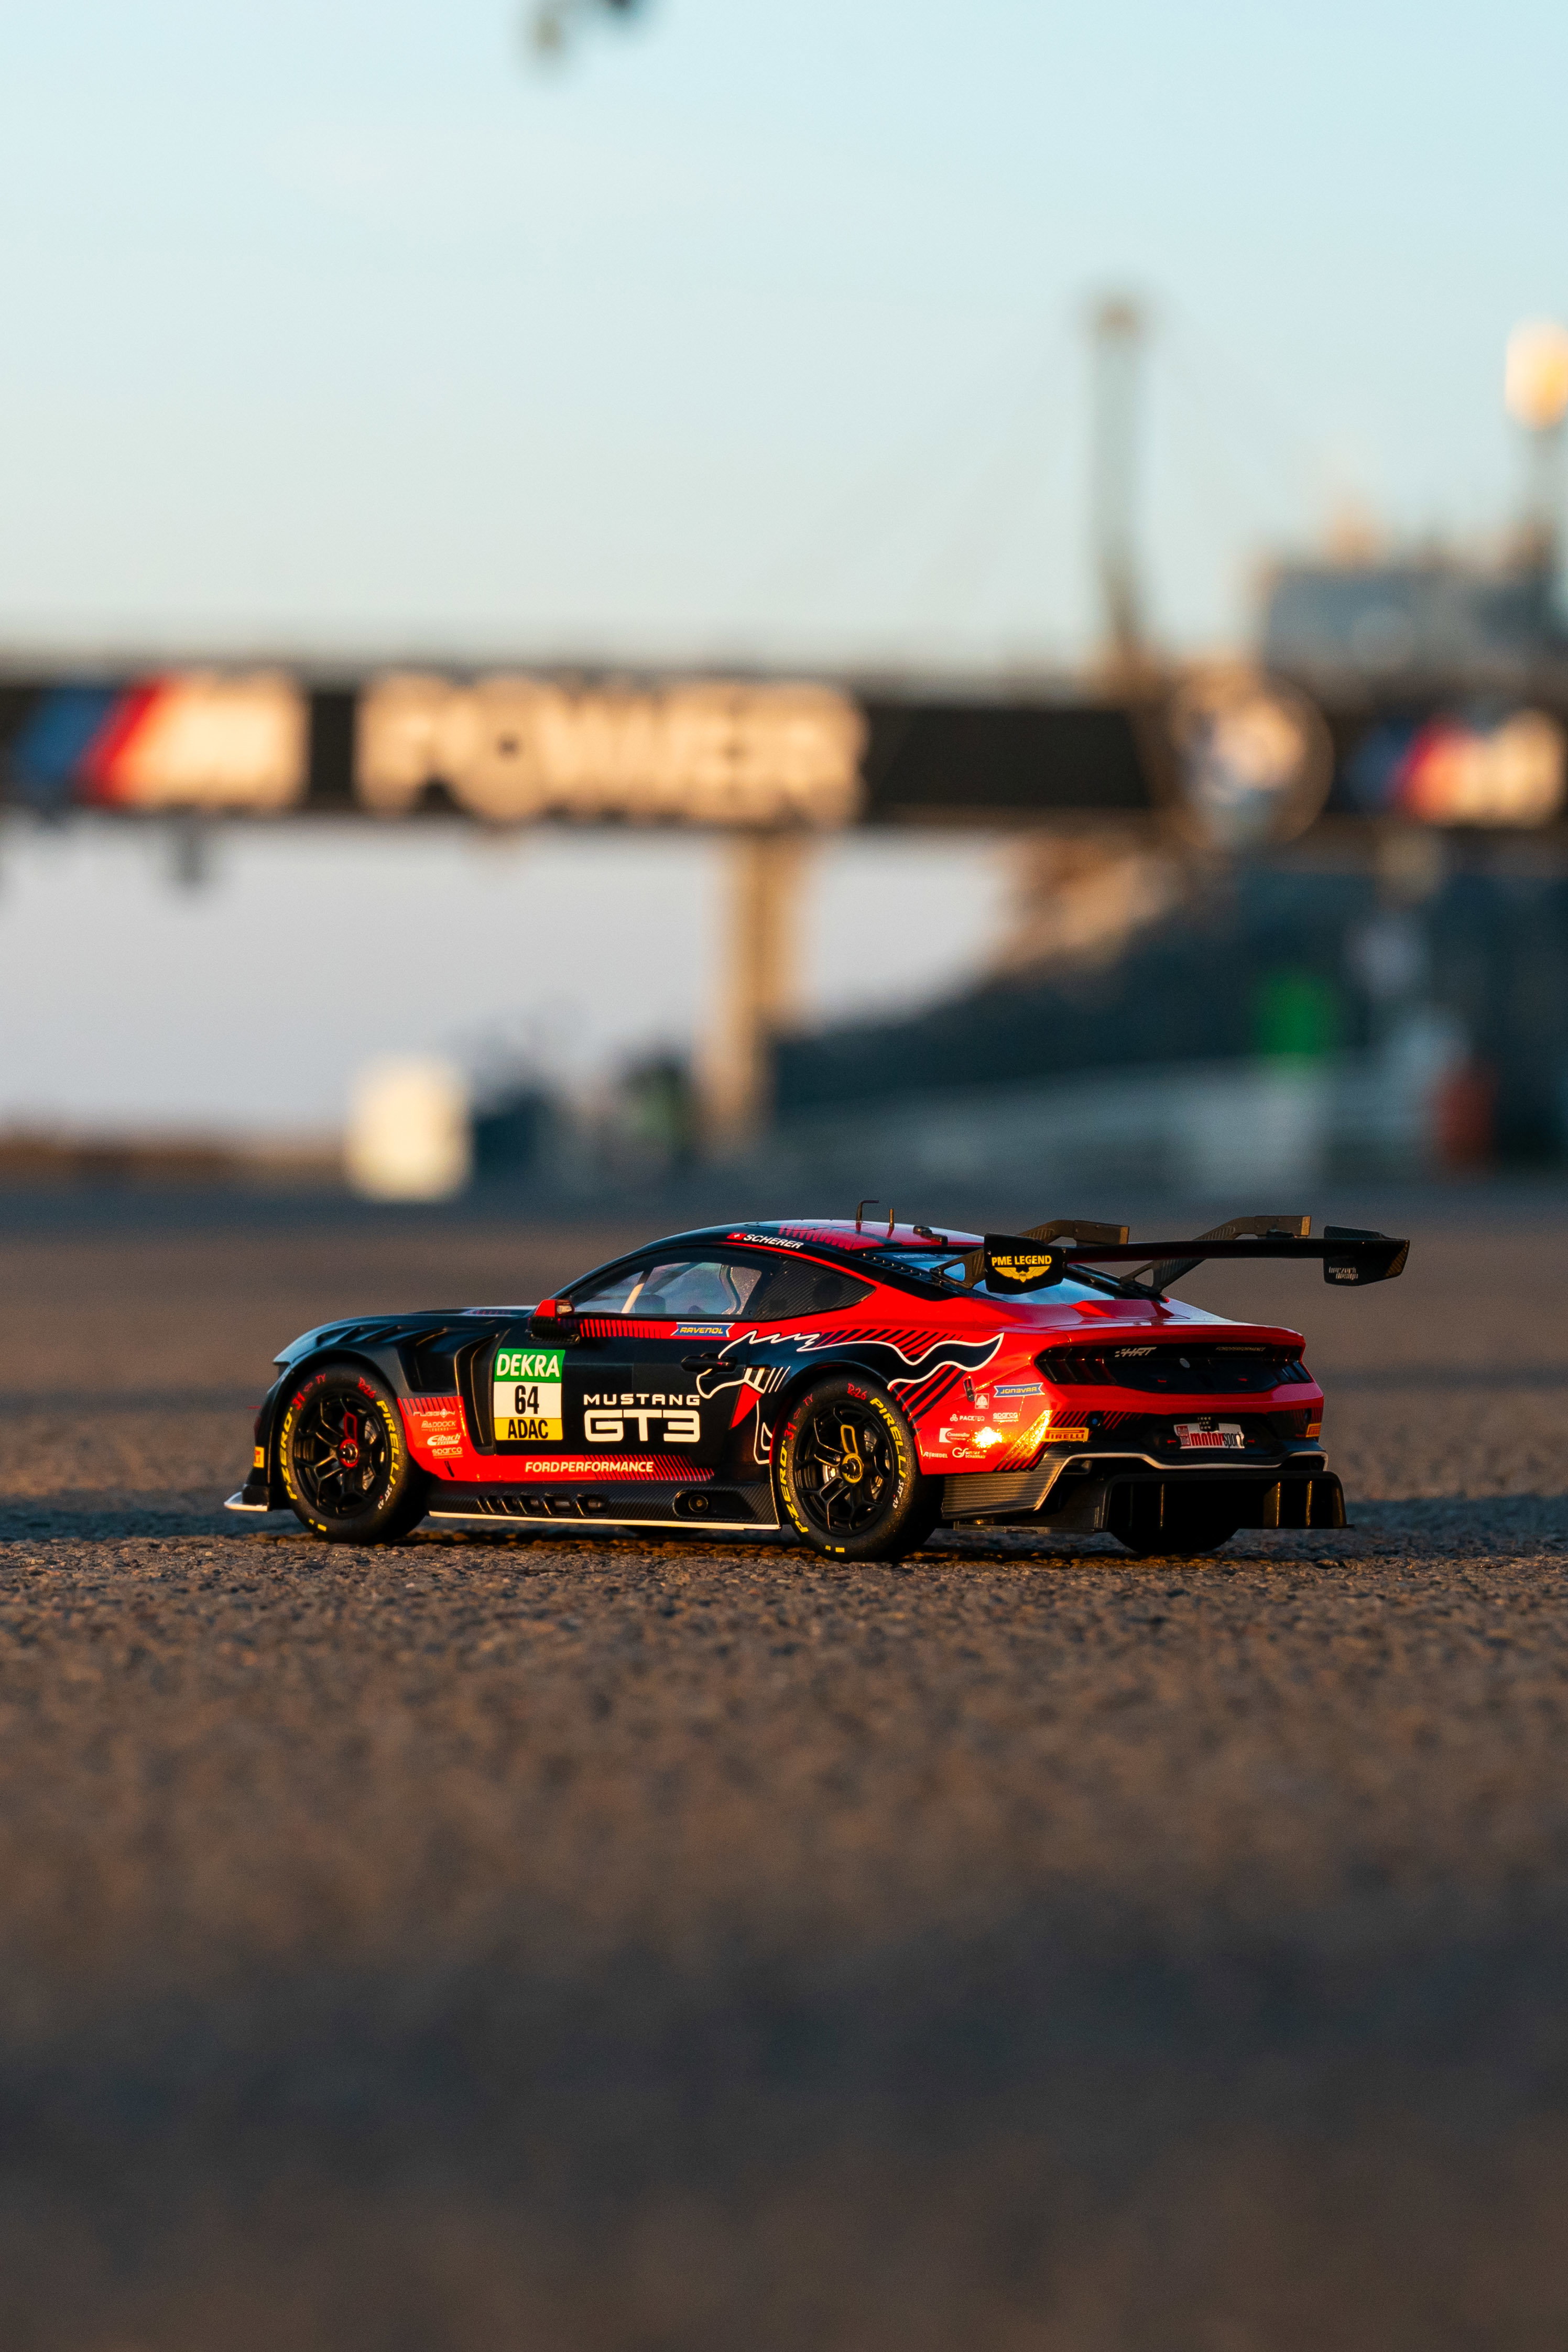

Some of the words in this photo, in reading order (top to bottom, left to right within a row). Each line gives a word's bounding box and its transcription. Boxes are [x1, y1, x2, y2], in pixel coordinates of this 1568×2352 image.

[744, 1234, 804, 1249] SCHERER
[992, 1256, 1012, 1266] PME
[1015, 1255, 1052, 1265] LEGEND
[497, 1354, 560, 1377] DEKRA
[515, 1385, 539, 1414] 64
[583, 1393, 700, 1406] MUSTANG
[508, 1419, 548, 1439] ADAC
[584, 1409, 700, 1442] GT3
[1045, 1430, 1085, 1439] PIRELLI
[376, 1400, 400, 1485] PIRELLI
[427, 1433, 461, 1445] Eibach
[870, 1398, 907, 1478] PIRELLI
